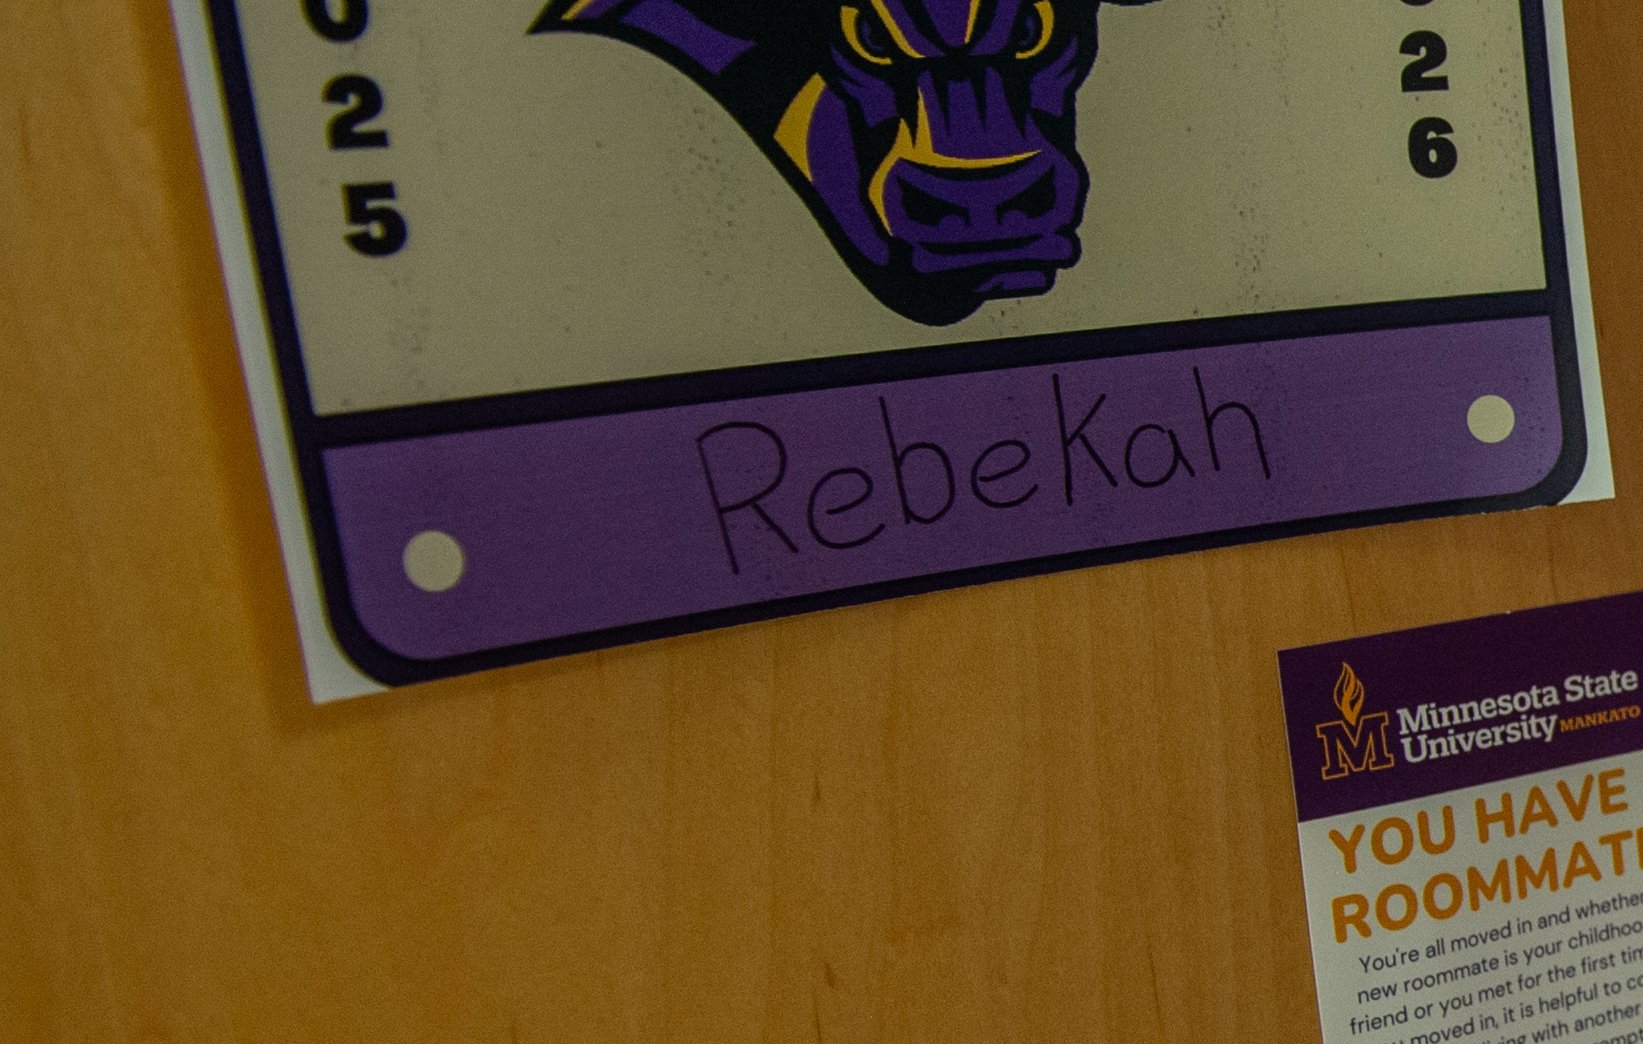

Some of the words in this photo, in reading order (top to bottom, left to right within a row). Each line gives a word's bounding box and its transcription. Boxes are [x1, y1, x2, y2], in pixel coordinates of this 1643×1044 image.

[1399, 0, 1458, 178] 26
[1395, 684, 1560, 736] Minnesota
[1562, 669, 1639, 702] State
[1399, 713, 1558, 764] University
[1558, 704, 1641, 732] MANKATO
[1326, 804, 1456, 874] YOU
[1473, 766, 1628, 844] HAVE
[1356, 982, 1398, 1004] new
[1402, 955, 1500, 993] roommate
[1502, 948, 1519, 967] is
[1521, 938, 1563, 966] your
[1357, 946, 1420, 974] You're
[1424, 936, 1446, 960] all
[1449, 919, 1513, 953] moved
[1515, 916, 1534, 935] in
[1536, 904, 1571, 930] and
[1348, 1004, 1409, 1036] friend
[1412, 1002, 1434, 1020] or
[1437, 992, 1474, 1018] you
[1476, 979, 1513, 1003] met
[1515, 972, 1543, 991] for
[1545, 964, 1577, 984] the
[1579, 952, 1616, 974] first
[1478, 1013, 1500, 1031] in,
[1501, 1006, 1516, 1024] it
[1518, 1001, 1535, 1019] is
[1536, 982, 1599, 1014] helpful
[1601, 980, 1623, 997] to
[1530, 1020, 1570, 1044] with
[1572, 1002, 1641, 1033] another
